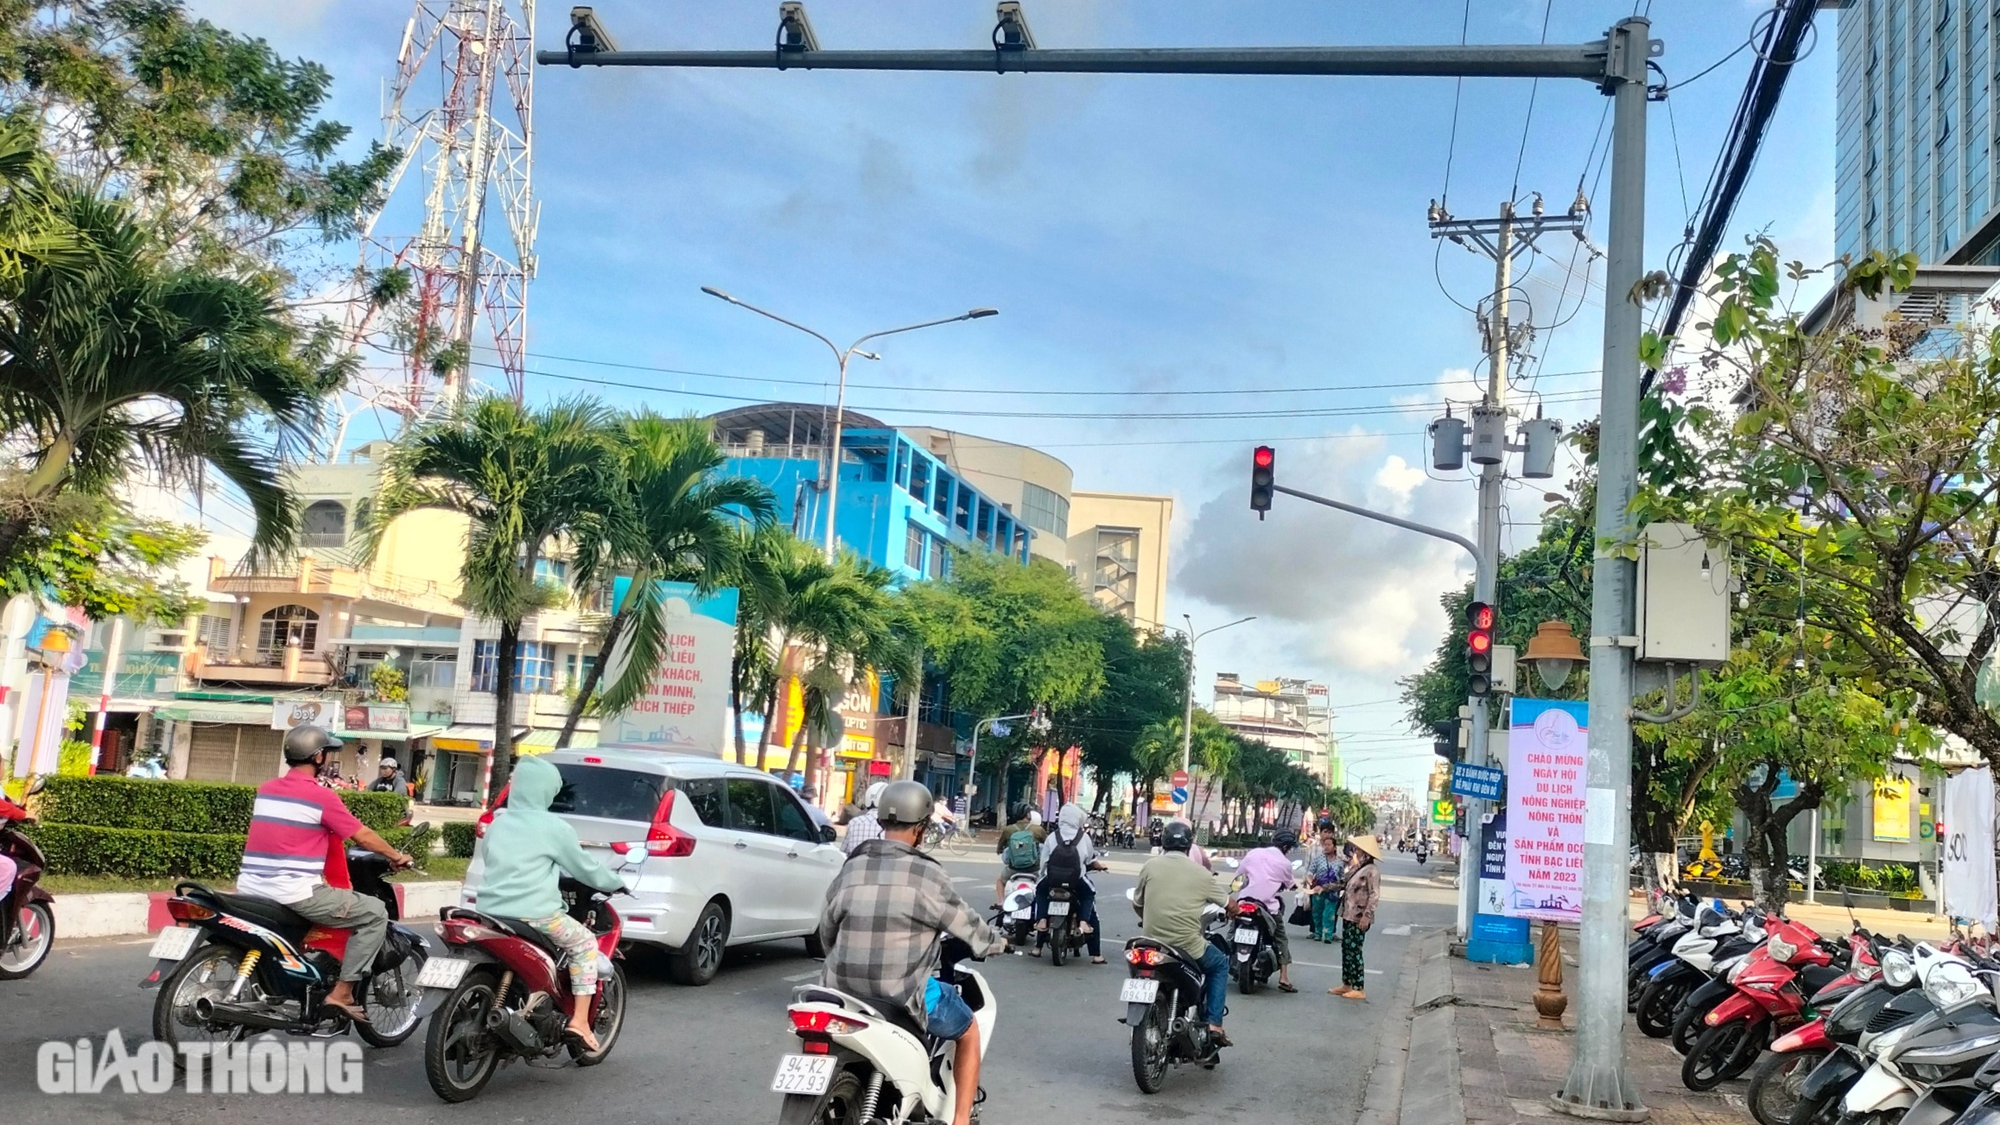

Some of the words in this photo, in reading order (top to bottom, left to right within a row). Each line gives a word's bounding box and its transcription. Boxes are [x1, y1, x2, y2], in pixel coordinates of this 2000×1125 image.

[669, 633, 696, 648] LỊCH
[670, 649, 695, 664] LIÊU
[662, 667, 703, 683] KHÁCH,
[662, 684, 696, 699] MINH,
[633, 699, 659, 715] LỊCH
[663, 701, 695, 717] THIỆP
[1527, 753, 1552, 764] CHÀO
[1555, 754, 1583, 766] MỪNG
[1533, 767, 1558, 779] NGÀY
[1561, 768, 1577, 782] HỘI
[1536, 783, 1549, 793] DU
[1552, 784, 1573, 796] LỊCH
[1522, 795, 1548, 807] NÔNG
[1528, 809, 1555, 822] NÔNG
[1558, 812, 1582, 824] THÔN
[1547, 826, 1559, 837] VÀ
[1514, 837, 1534, 850] SẢN
[1536, 838, 1564, 852] PHẨM
[1567, 843, 1584, 853] OCO
[1486, 853, 1504, 862] NGUY
[1520, 852, 1541, 865] TỈNH
[1544, 856, 1563, 868] BẠC
[1485, 864, 1501, 873] TÍNH
[1528, 868, 1551, 880] NĂM
[1554, 872, 1577, 882] 2023
[429, 959, 460, 972] 94-K1
[418, 972, 459, 987] 212.72
[1128, 980, 1153, 990] 94-K1
[1122, 990, 1154, 1001] 094.18
[786, 1057, 828, 1074] 94-K2
[775, 1074, 827, 1091] 327.93
